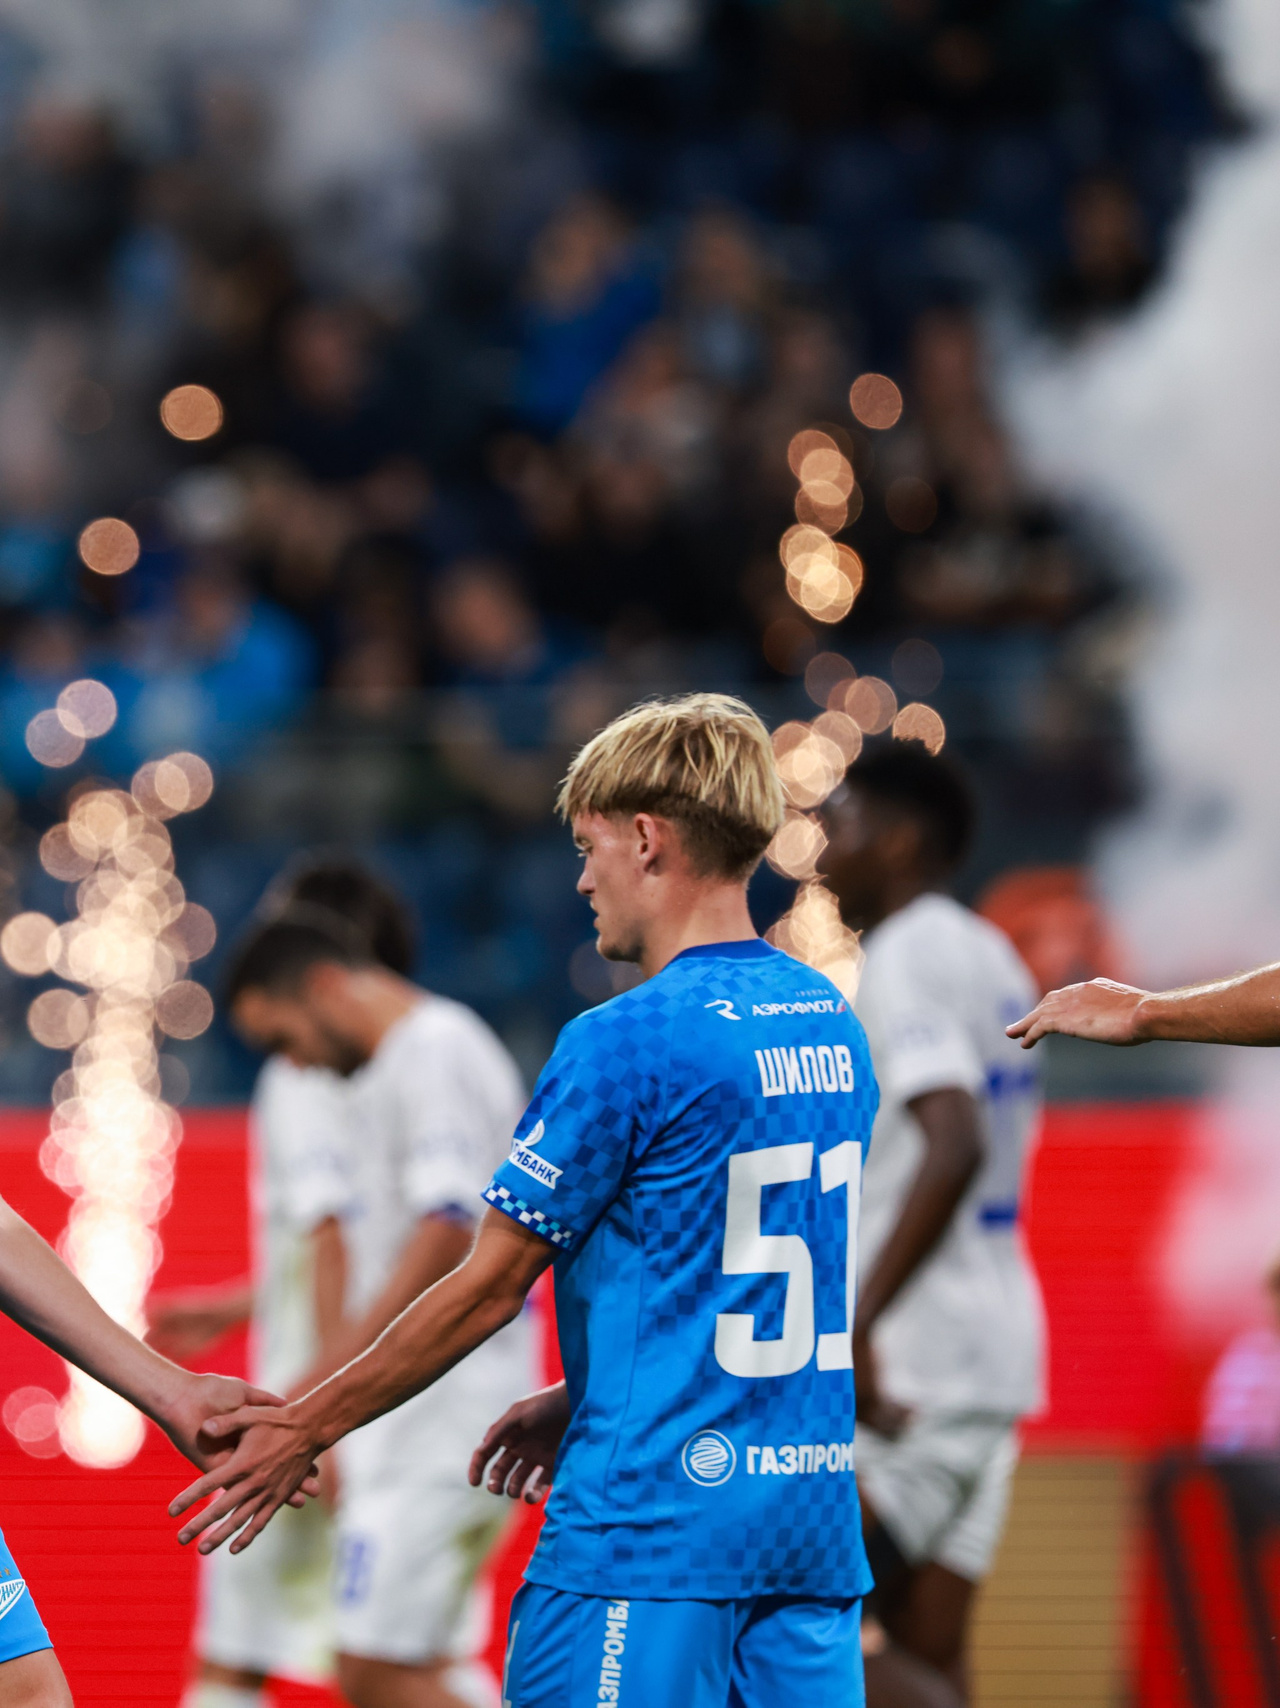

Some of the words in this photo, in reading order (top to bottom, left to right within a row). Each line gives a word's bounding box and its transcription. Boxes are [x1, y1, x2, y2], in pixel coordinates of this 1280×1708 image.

[752, 999, 835, 1017] АЭРОФЛОТ
[754, 1044, 855, 1098] ШИЛОВ
[513, 1149, 556, 1184] МБАНК
[713, 1139, 863, 1379] 51
[746, 1442, 856, 1476] ГАЗПРОМ
